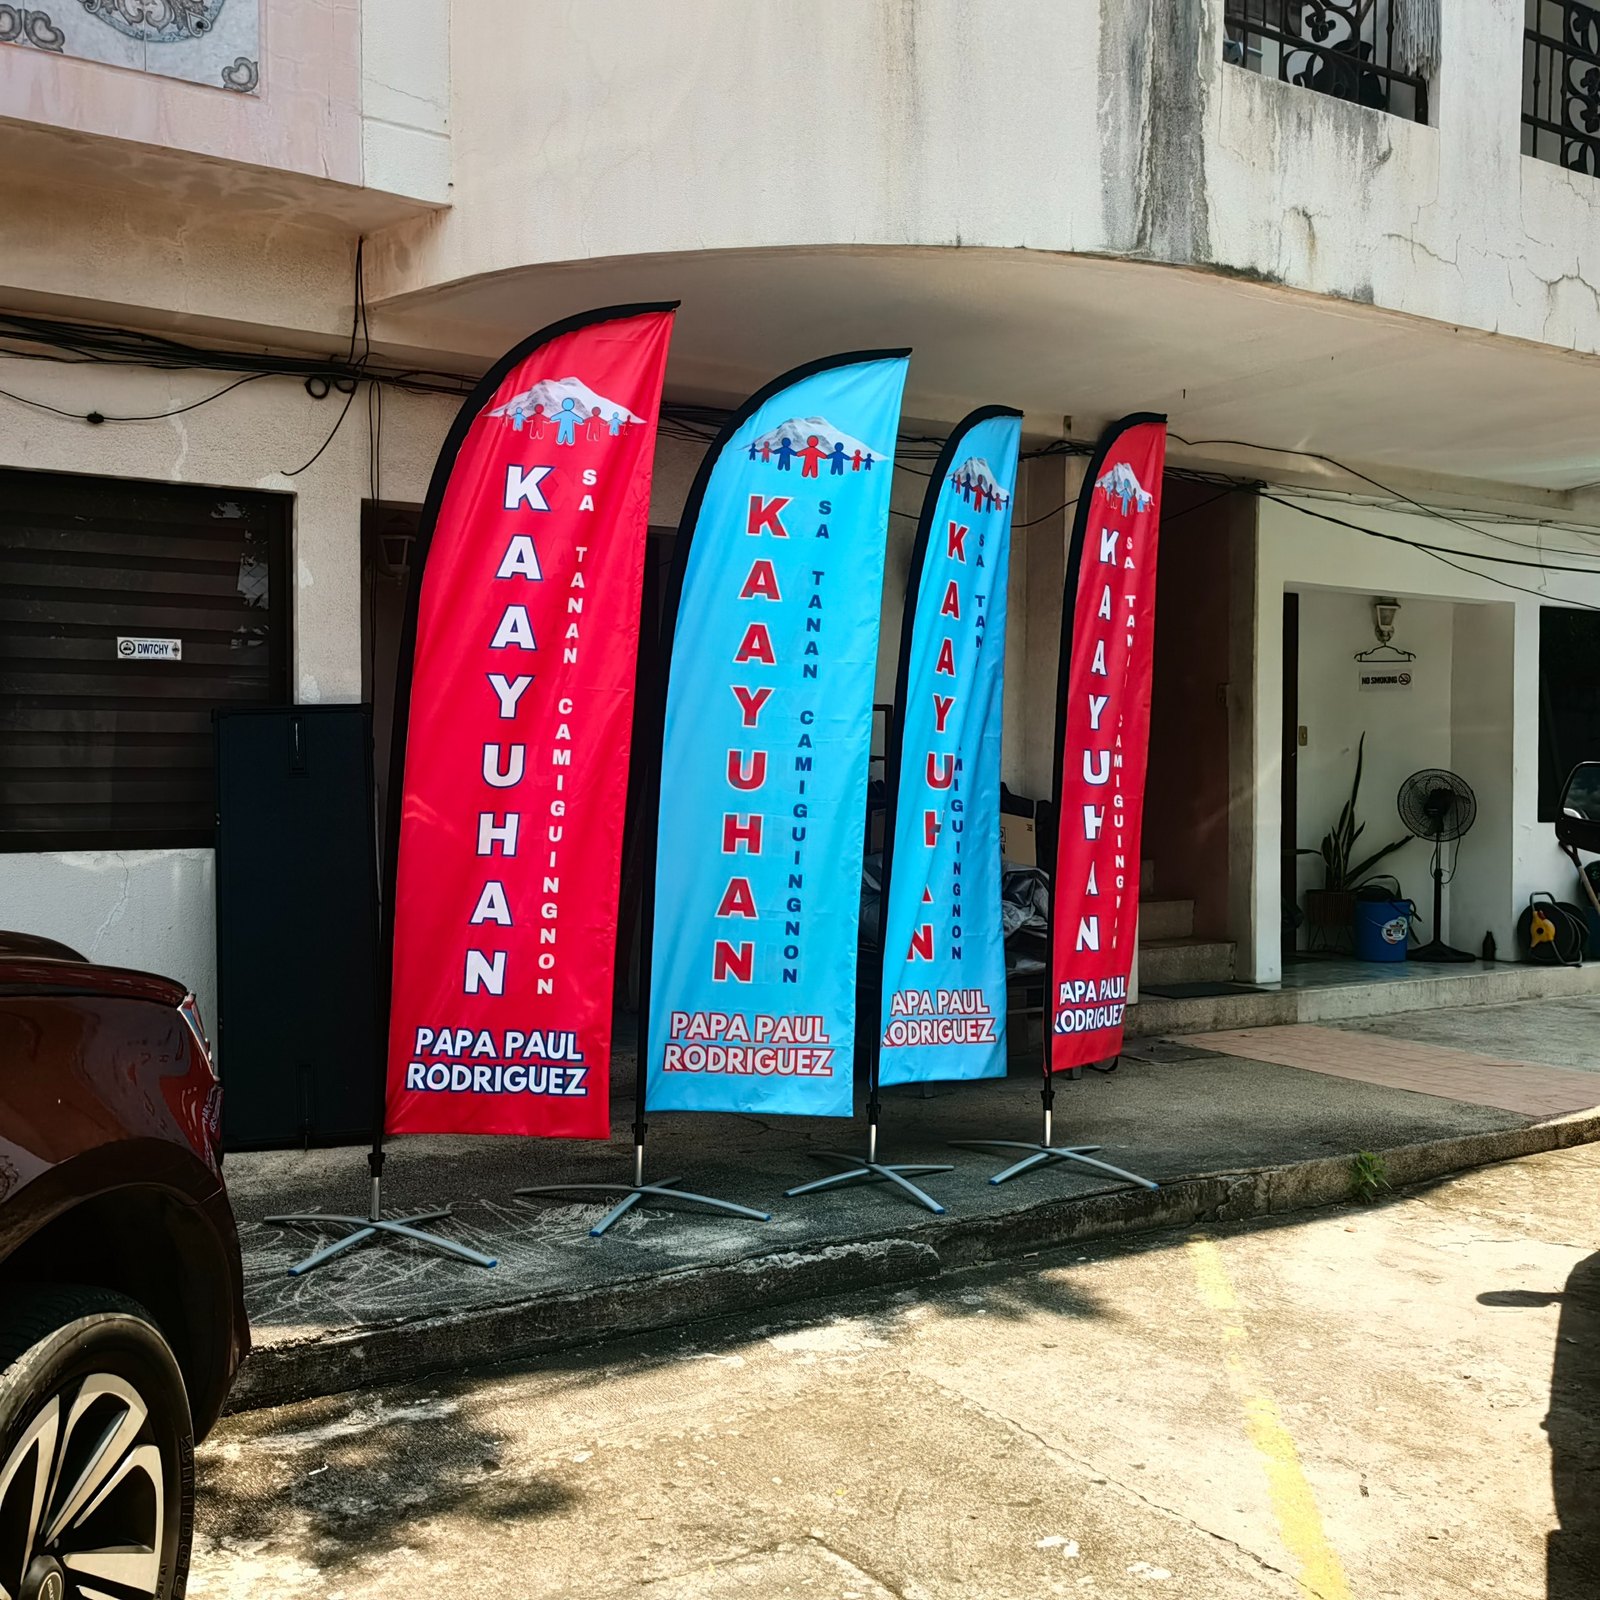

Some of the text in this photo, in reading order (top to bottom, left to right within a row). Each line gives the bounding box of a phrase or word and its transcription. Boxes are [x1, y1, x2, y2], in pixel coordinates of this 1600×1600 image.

[975, 533, 986, 568] SA
[1123, 536, 1136, 569] SA
[137, 643, 169, 655] DW7CHY
[1361, 676, 1397, 685] NO SMOKING
[463, 464, 555, 996] KAAYUHAN
[536, 469, 598, 995] SA TANAN CAMIGUINGNON
[712, 493, 794, 984] KAAYUHAN
[782, 500, 832, 984] SA TANAN CAMIGUINGNON
[936, 988, 990, 1015] PAUL
[1099, 975, 1127, 1001] PAUL
[414, 1026, 584, 1062] PAPA PAUL
[668, 1011, 830, 1044] PAPA PAUL
[662, 1043, 835, 1077] RODRIGUEZ
[405, 1062, 590, 1097] RODRIGUEZ
